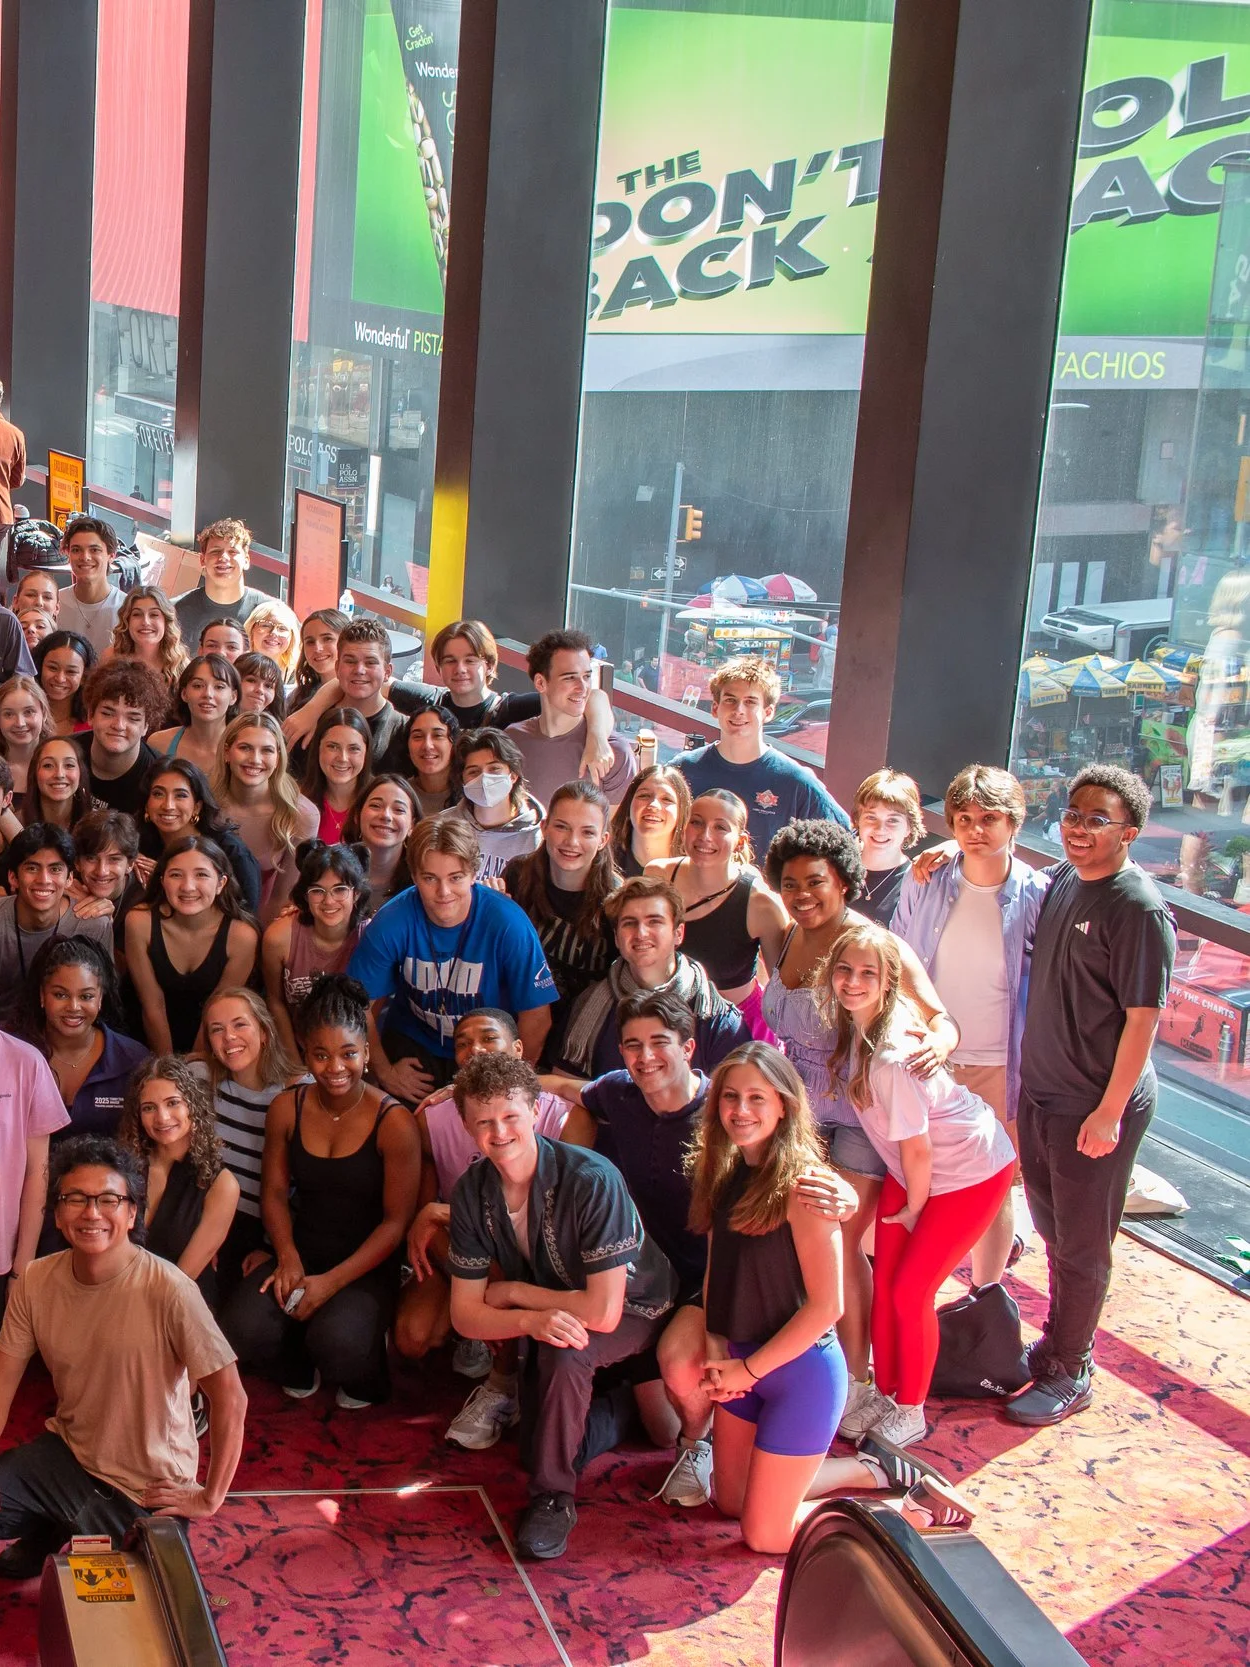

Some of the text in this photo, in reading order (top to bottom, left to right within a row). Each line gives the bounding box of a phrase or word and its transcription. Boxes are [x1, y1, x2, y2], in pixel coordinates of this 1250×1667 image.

[408, 24, 424, 38] Get
[617, 150, 701, 195] THE
[354, 320, 410, 350] Wonderful
[94, 1096, 110, 1104] 2025
[85, 1594, 127, 1602] CAUTION
